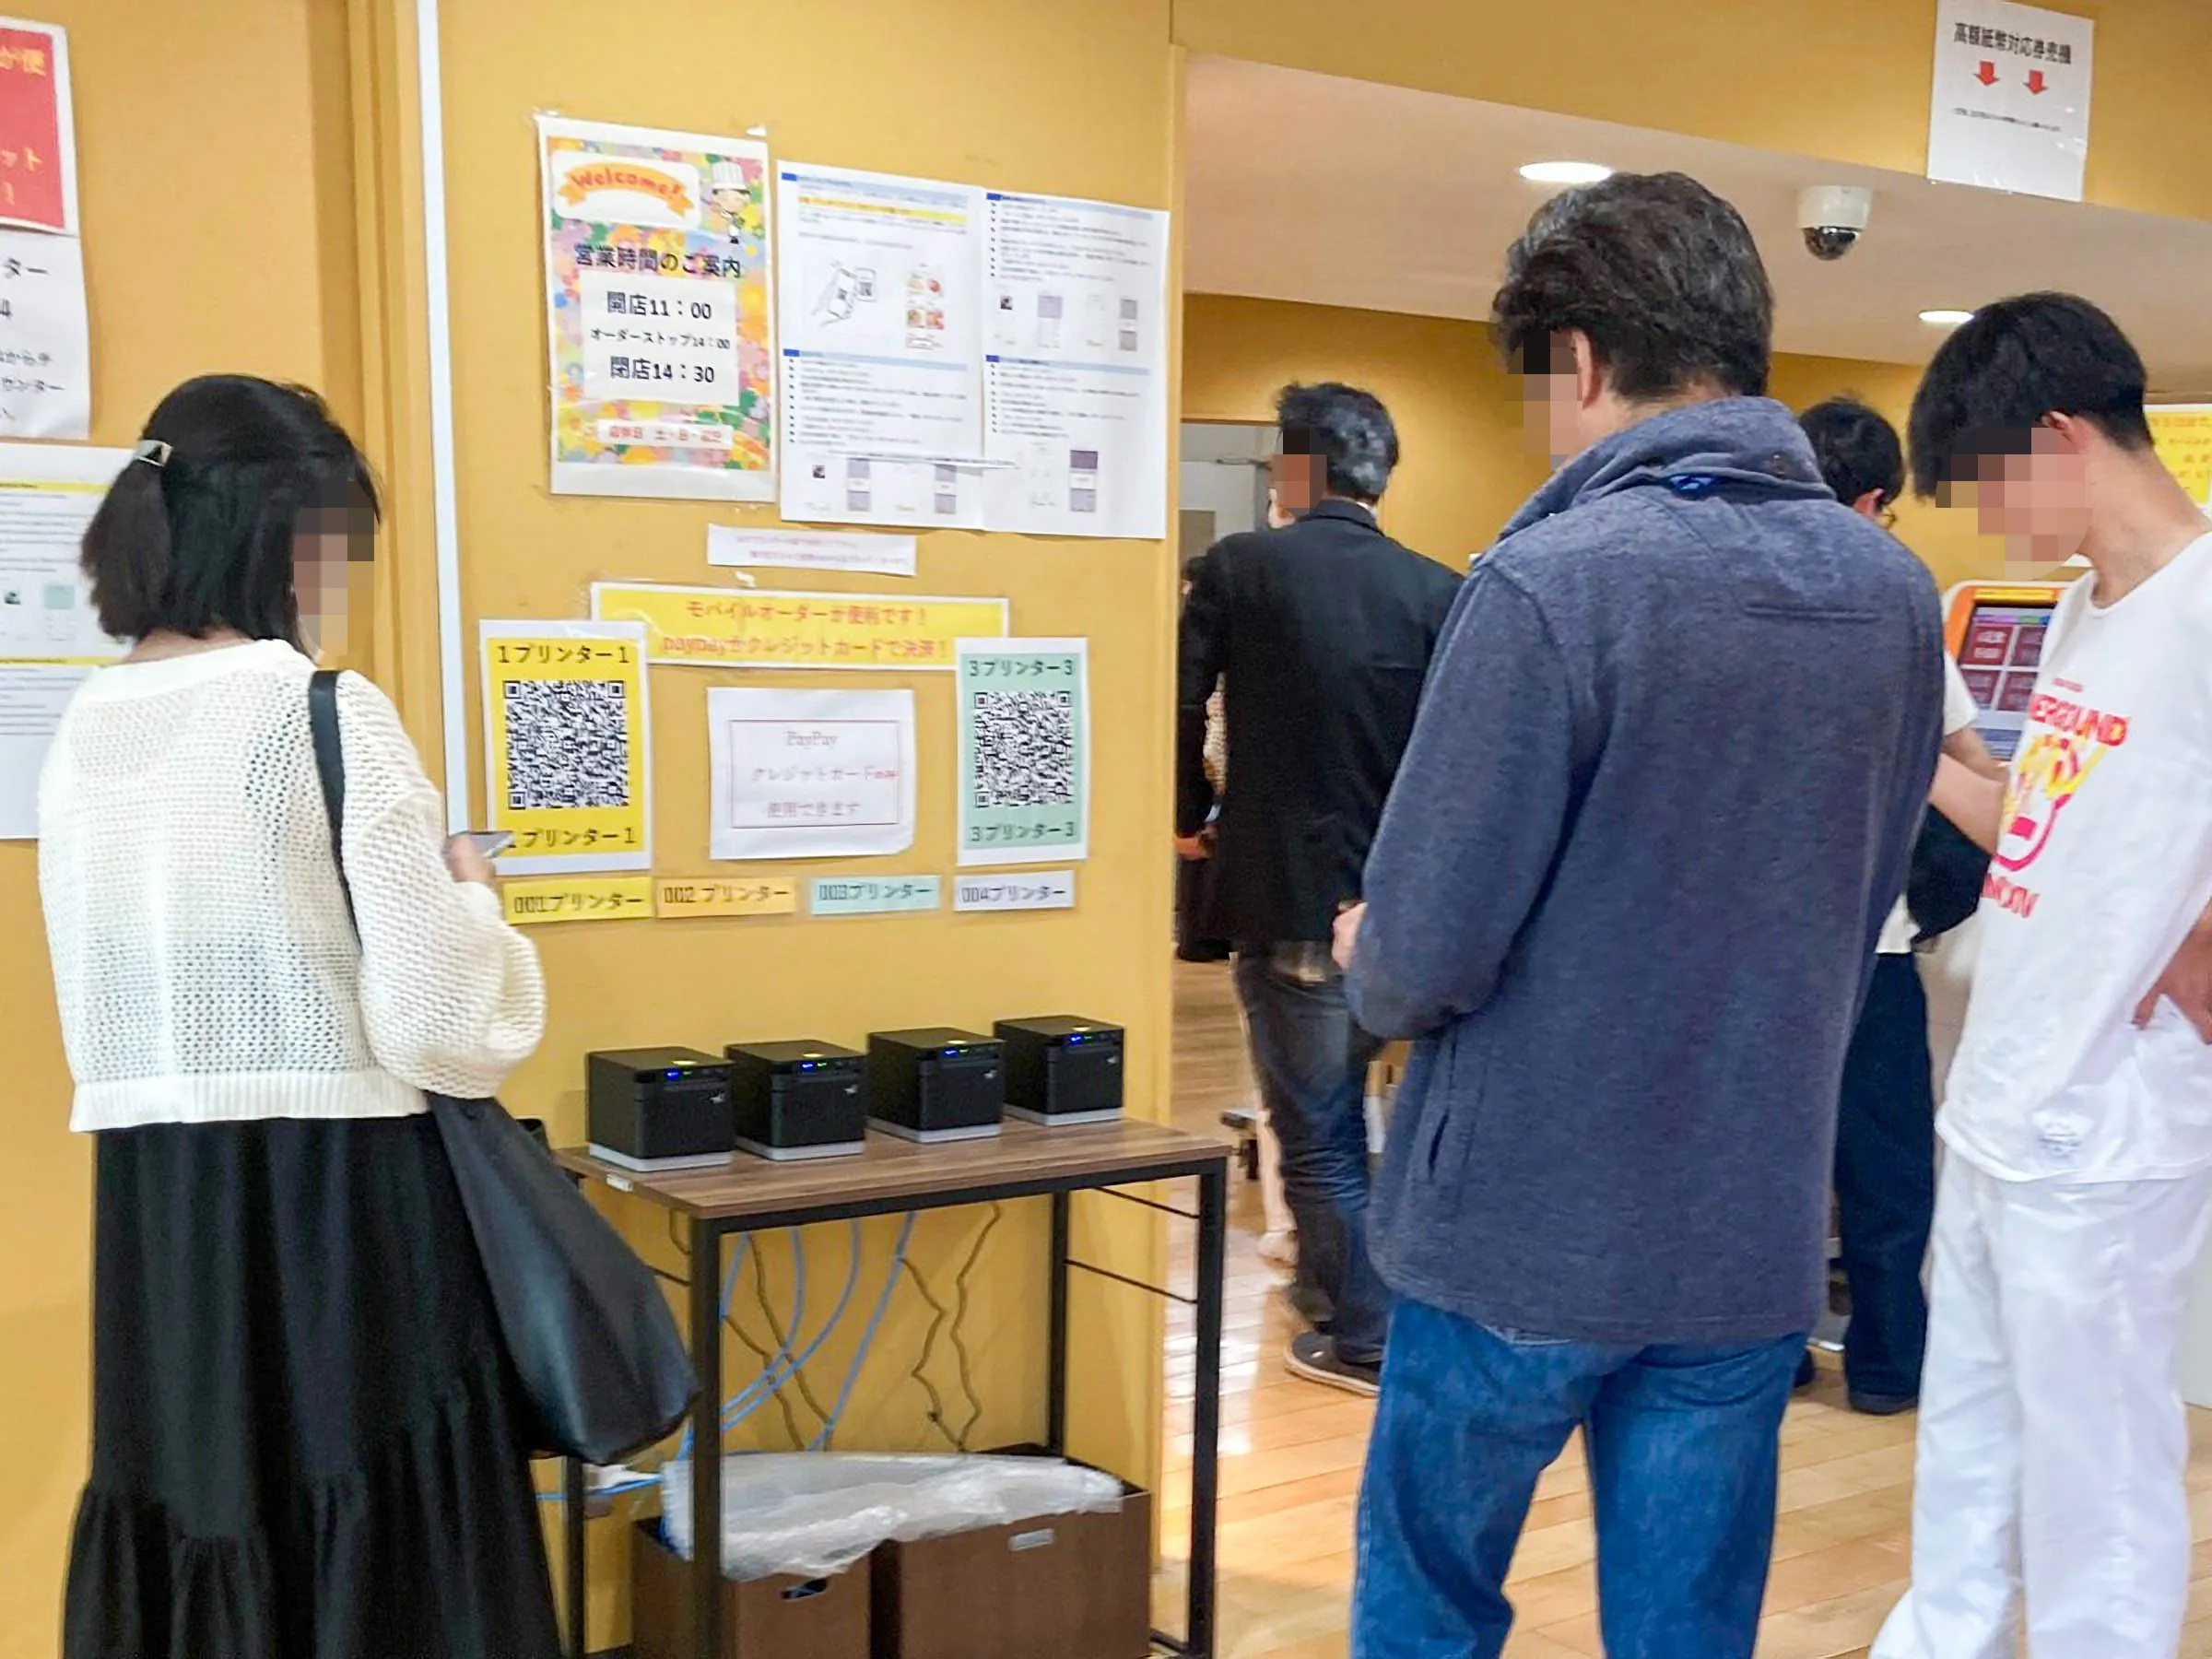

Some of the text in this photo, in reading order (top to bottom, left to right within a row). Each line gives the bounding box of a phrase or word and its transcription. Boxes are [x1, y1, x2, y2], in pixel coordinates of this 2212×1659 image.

[571, 167, 683, 200] Welcome!
[574, 242, 741, 278] 営業時間のご案内
[498, 643, 629, 664] 1プリンター1
[968, 658, 1074, 677] 3プリンター3
[786, 731, 839, 749] PayPay
[507, 826, 636, 848] プリンター1
[970, 820, 1075, 842] 3プリンター3
[513, 891, 644, 913] 001プリンター
